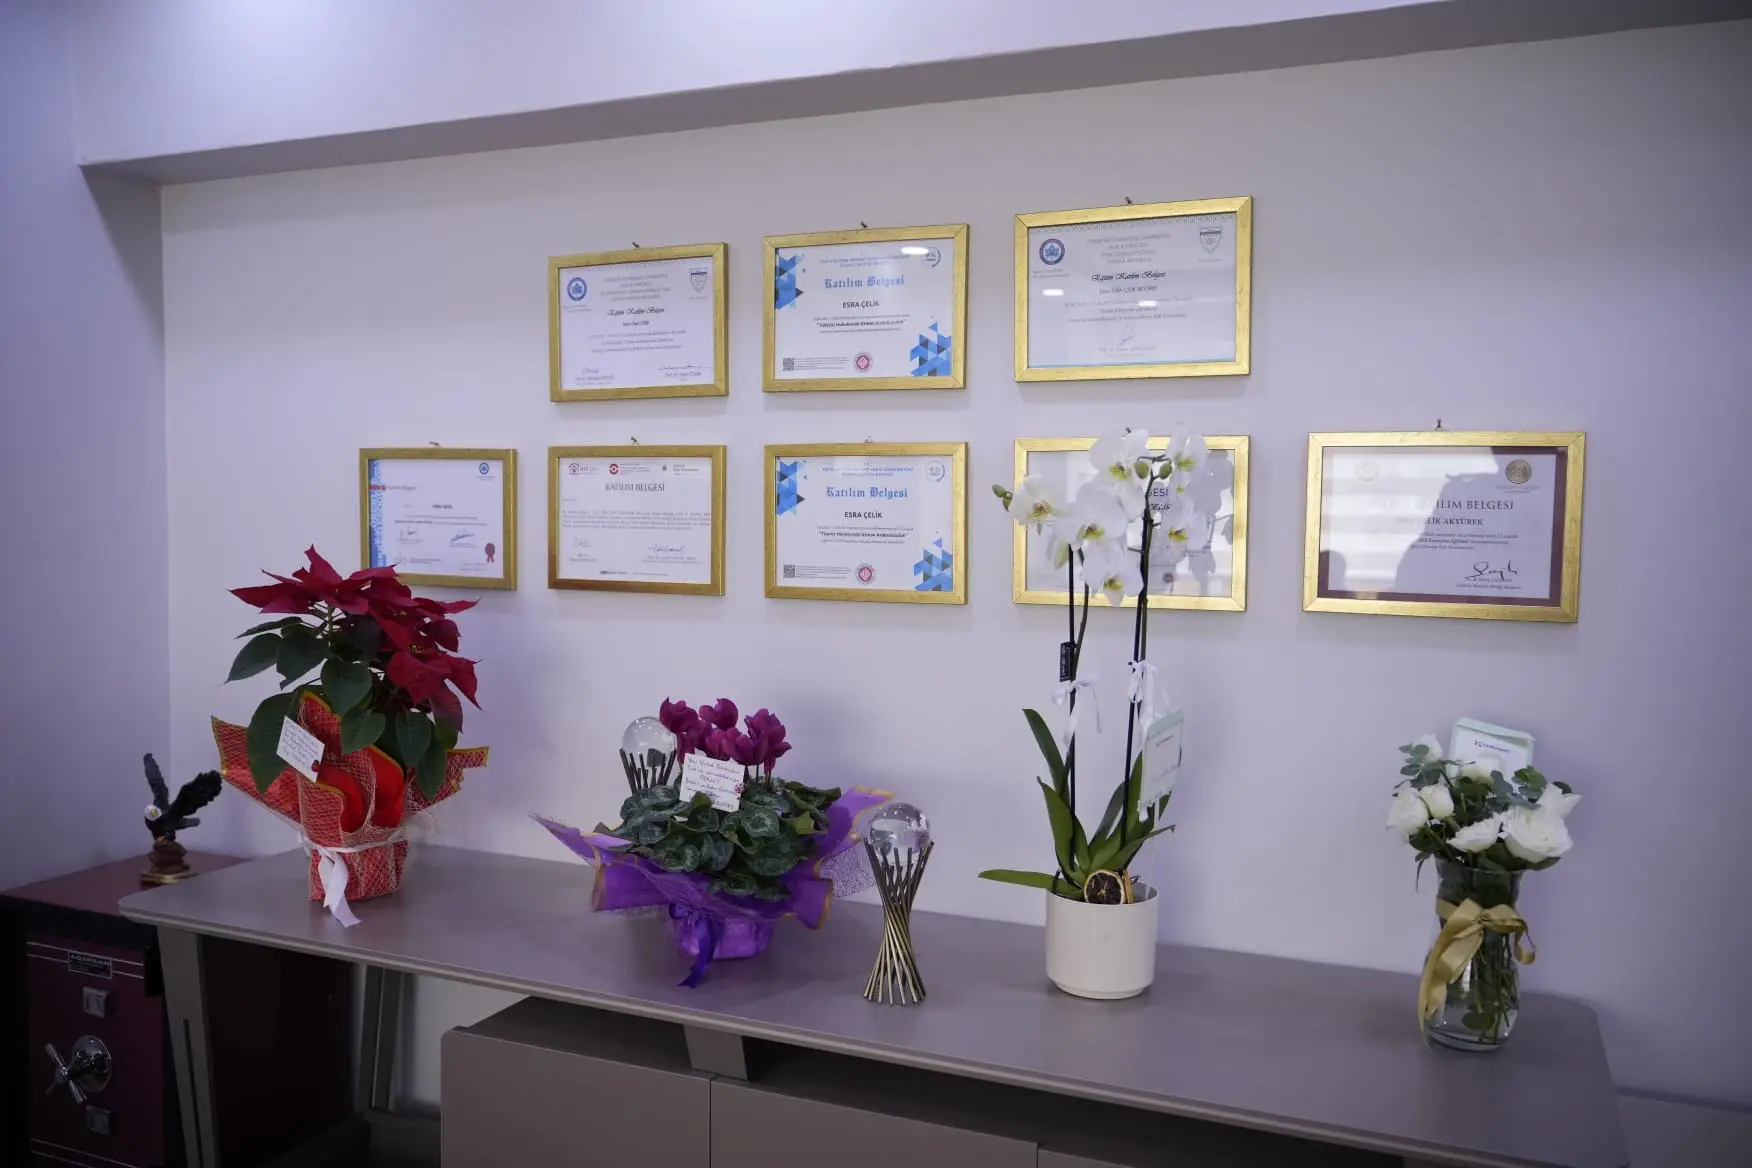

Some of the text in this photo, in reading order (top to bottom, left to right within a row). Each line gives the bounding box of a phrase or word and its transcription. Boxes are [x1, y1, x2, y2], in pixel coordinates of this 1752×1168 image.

[824, 274, 905, 289] Katılım Belgesi
[842, 301, 860, 309] ESRA
[605, 482, 665, 492] KATILIM BELGESİ
[827, 486, 908, 500] Katılım Belgesi
[863, 510, 883, 519] ÇELİK
[1443, 515, 1484, 525] AKYÜREK
